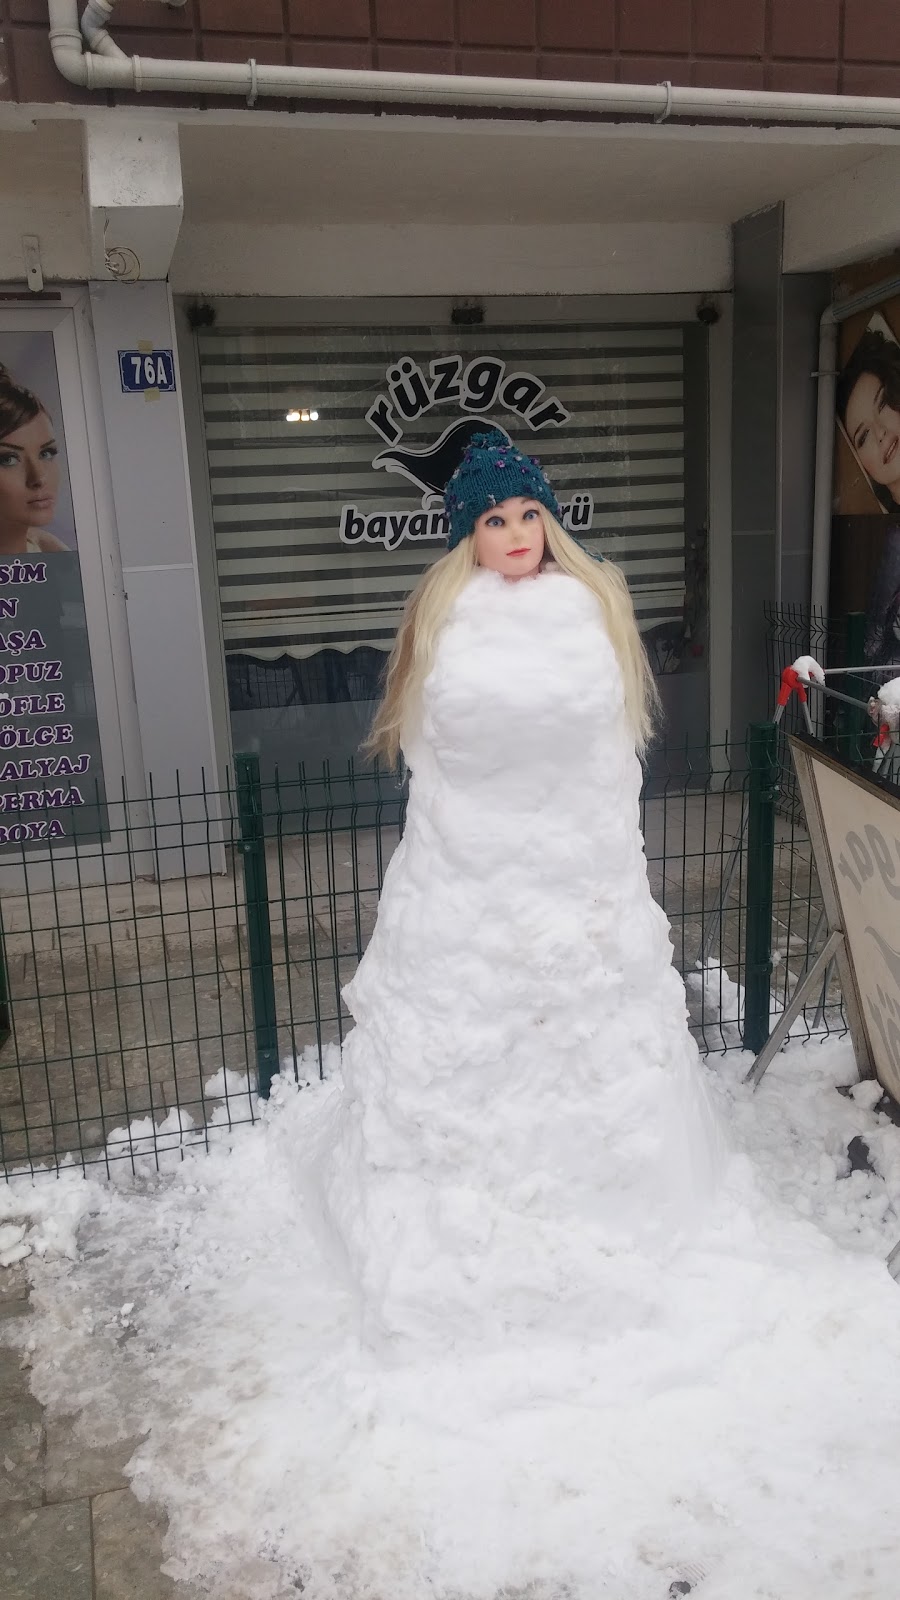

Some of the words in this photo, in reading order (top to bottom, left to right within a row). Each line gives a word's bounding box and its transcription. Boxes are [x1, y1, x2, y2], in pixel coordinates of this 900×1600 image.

[131, 356, 168, 385] 76A
[366, 356, 570, 446] rüzgar
[341, 504, 449, 549] bayan
[0, 724, 73, 749] ÖLGE
[0, 754, 90, 781] ALYAJ
